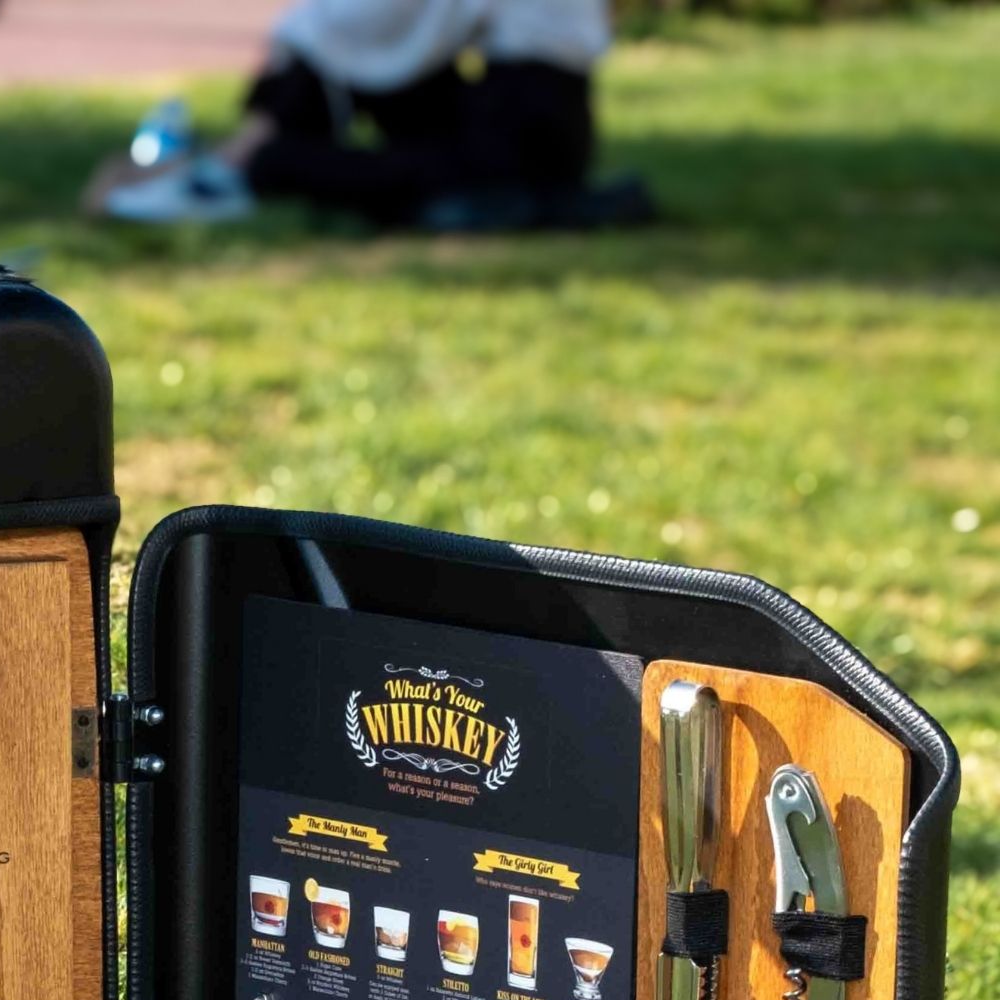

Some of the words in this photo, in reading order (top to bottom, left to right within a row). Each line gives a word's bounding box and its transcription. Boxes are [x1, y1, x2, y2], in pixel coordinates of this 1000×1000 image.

[384, 679, 441, 702] What's
[444, 684, 484, 714] Your
[361, 702, 505, 767] WHISKEY
[383, 767, 396, 778] For
[397, 771, 403, 779] a
[405, 772, 431, 785] reason
[433, 778, 441, 787] or
[443, 780, 448, 788] a
[388, 782, 415, 795] what's
[416, 786, 435, 798] your
[436, 791, 474, 806] pleasure?
[307, 817, 321, 830] The
[323, 821, 348, 837] Manly
[350, 826, 368, 838] Man
[498, 854, 513, 867] The
[514, 857, 536, 874] Girly
[537, 862, 555, 875] Girl
[251, 938, 286, 953] MANHATTAN
[308, 950, 320, 961] OLD
[320, 952, 351, 966] FASHIONED
[376, 964, 405, 978] STRAIGHT
[442, 978, 469, 992] STILETTO
